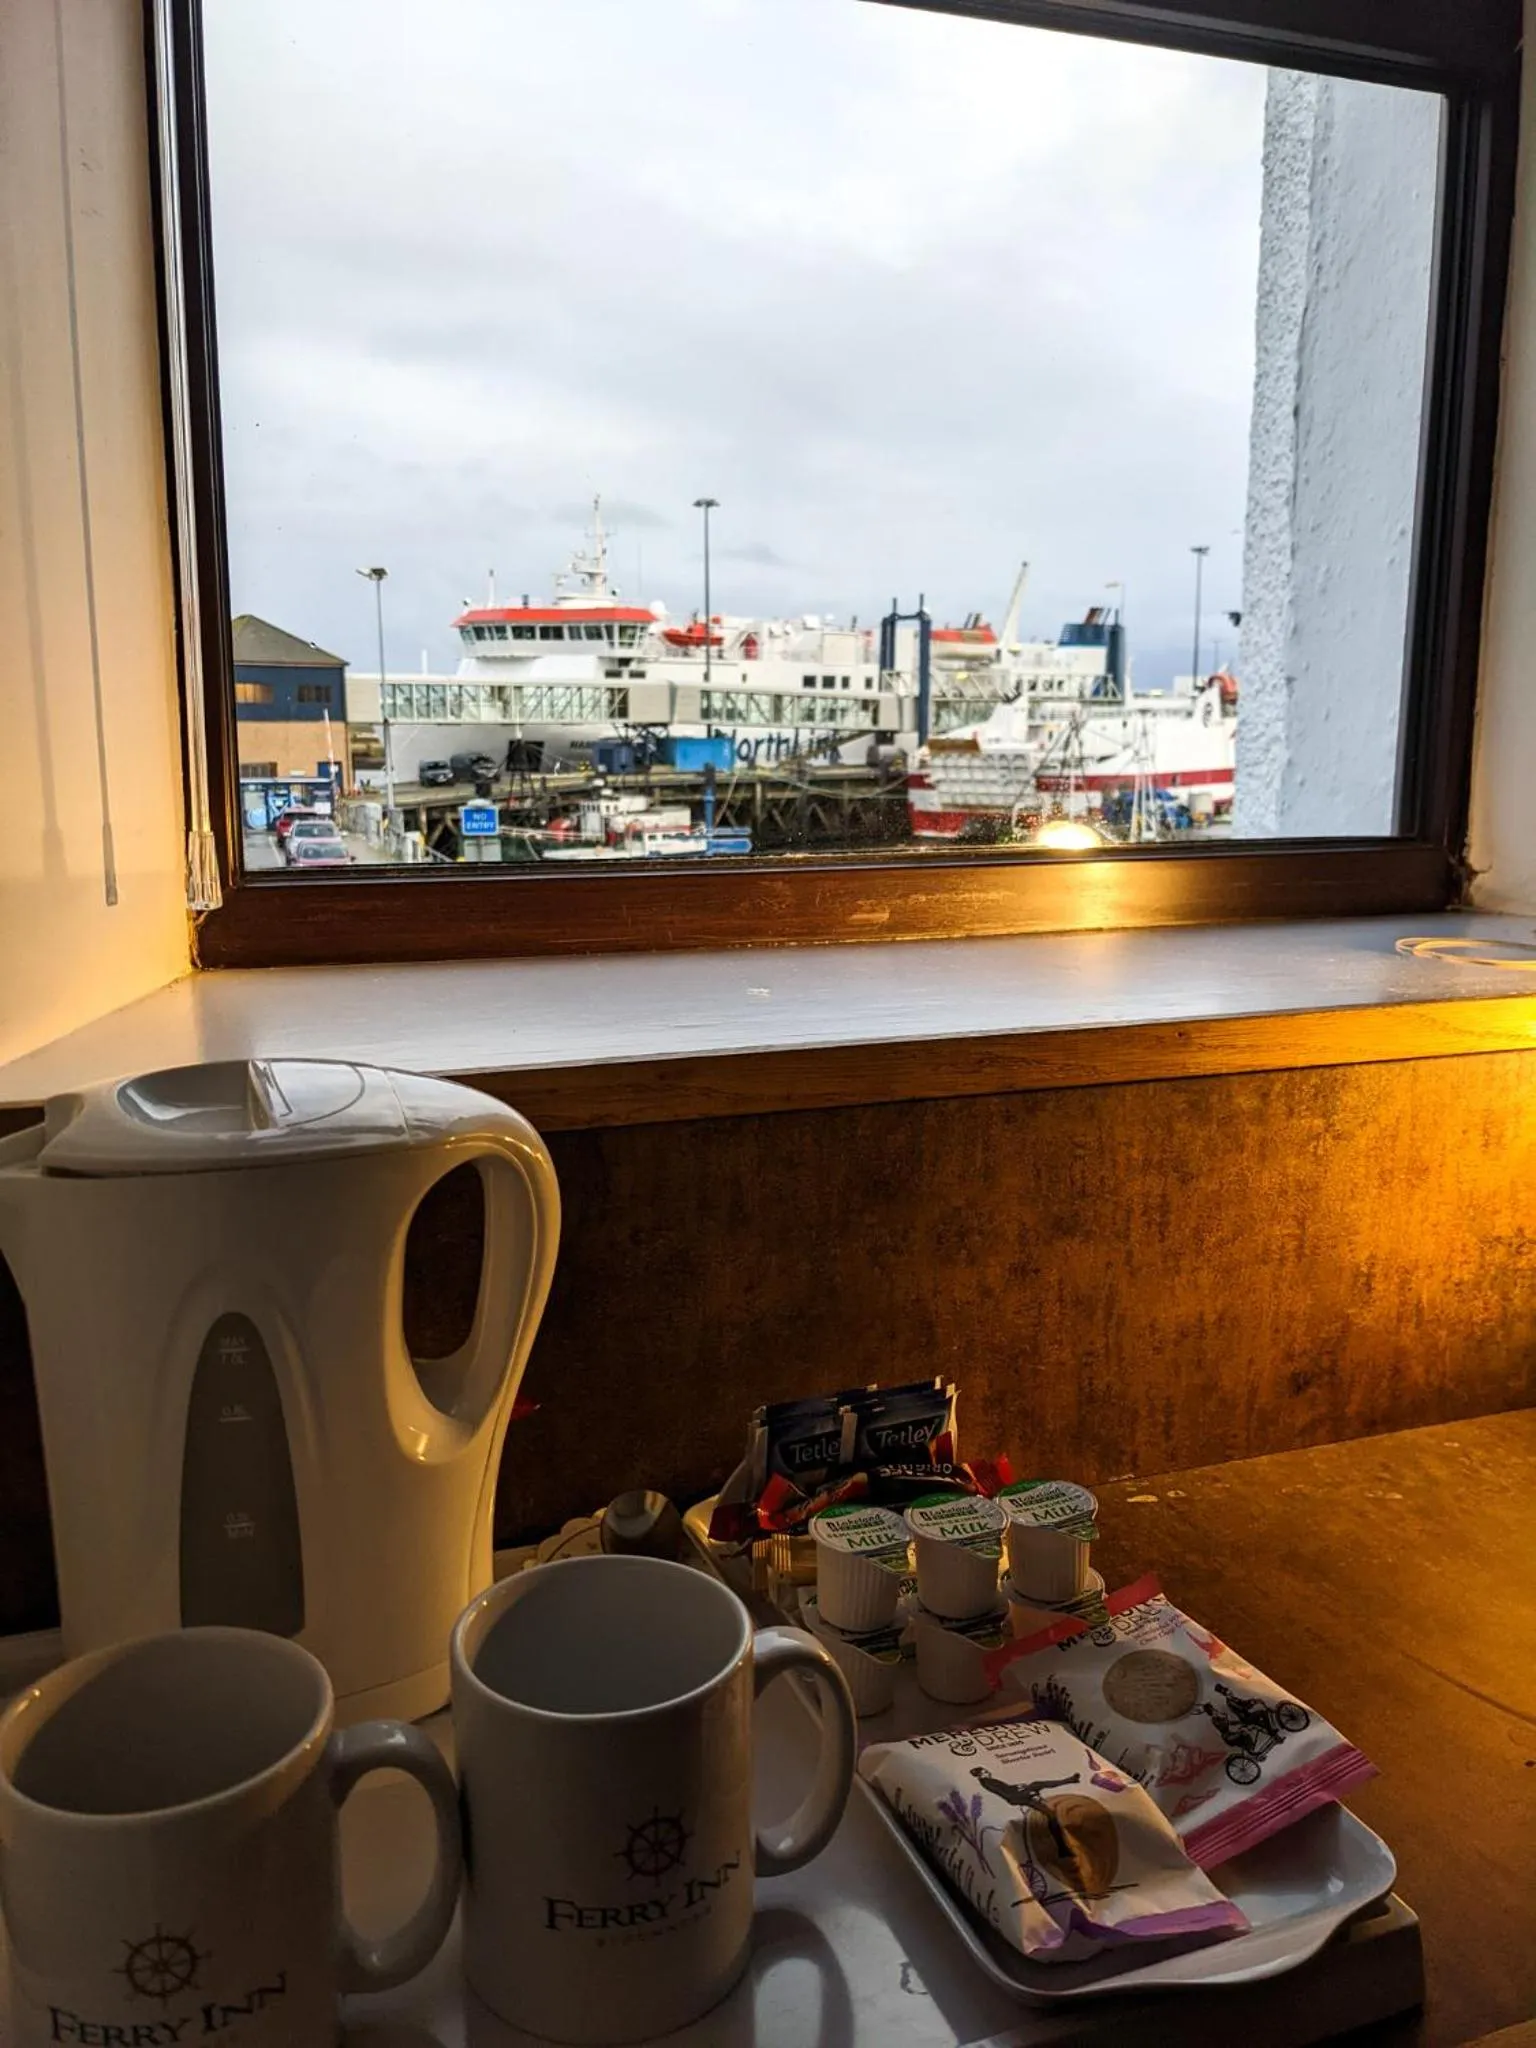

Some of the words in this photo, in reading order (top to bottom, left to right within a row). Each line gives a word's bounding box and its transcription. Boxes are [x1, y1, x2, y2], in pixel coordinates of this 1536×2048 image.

[466, 822, 494, 830] ENTRY
[473, 813, 487, 821] NO
[875, 1418, 941, 1449] Tetley
[789, 1438, 842, 1465] Tetle
[1031, 1504, 1085, 1522] Milk
[939, 1521, 994, 1537] Milk
[845, 1532, 901, 1549] Milk
[974, 1723, 1051, 1747] DREW
[542, 1893, 677, 1932] FERRY
[683, 1850, 741, 1908] INN
[48, 2005, 192, 2048] FERRY
[200, 1970, 288, 2036] INN
